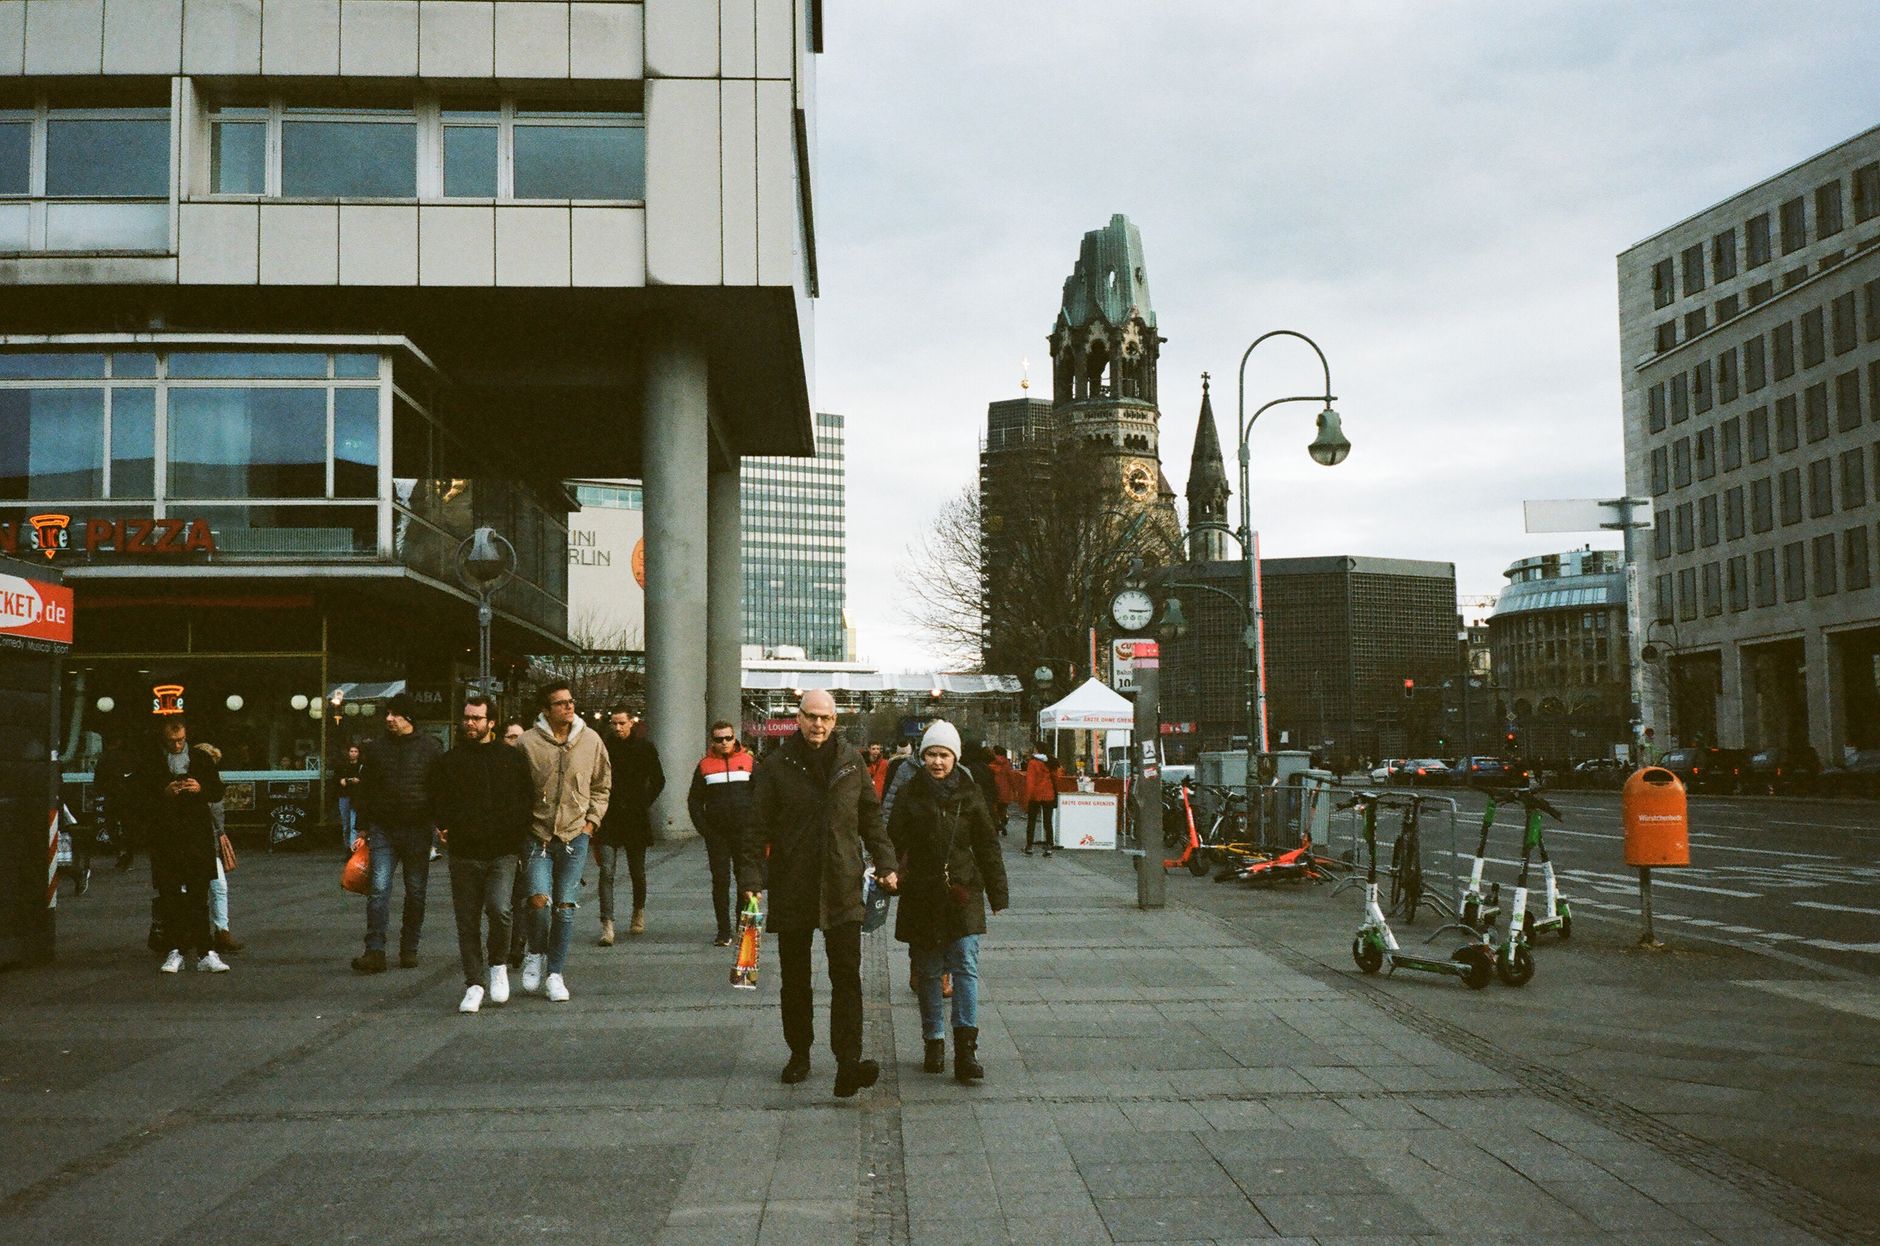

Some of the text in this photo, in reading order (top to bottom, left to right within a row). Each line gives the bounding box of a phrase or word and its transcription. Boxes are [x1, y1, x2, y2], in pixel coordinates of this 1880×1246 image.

[86, 519, 215, 552] PIZZA
[568, 530, 595, 546] INI
[768, 723, 799, 731] LOUNGE
